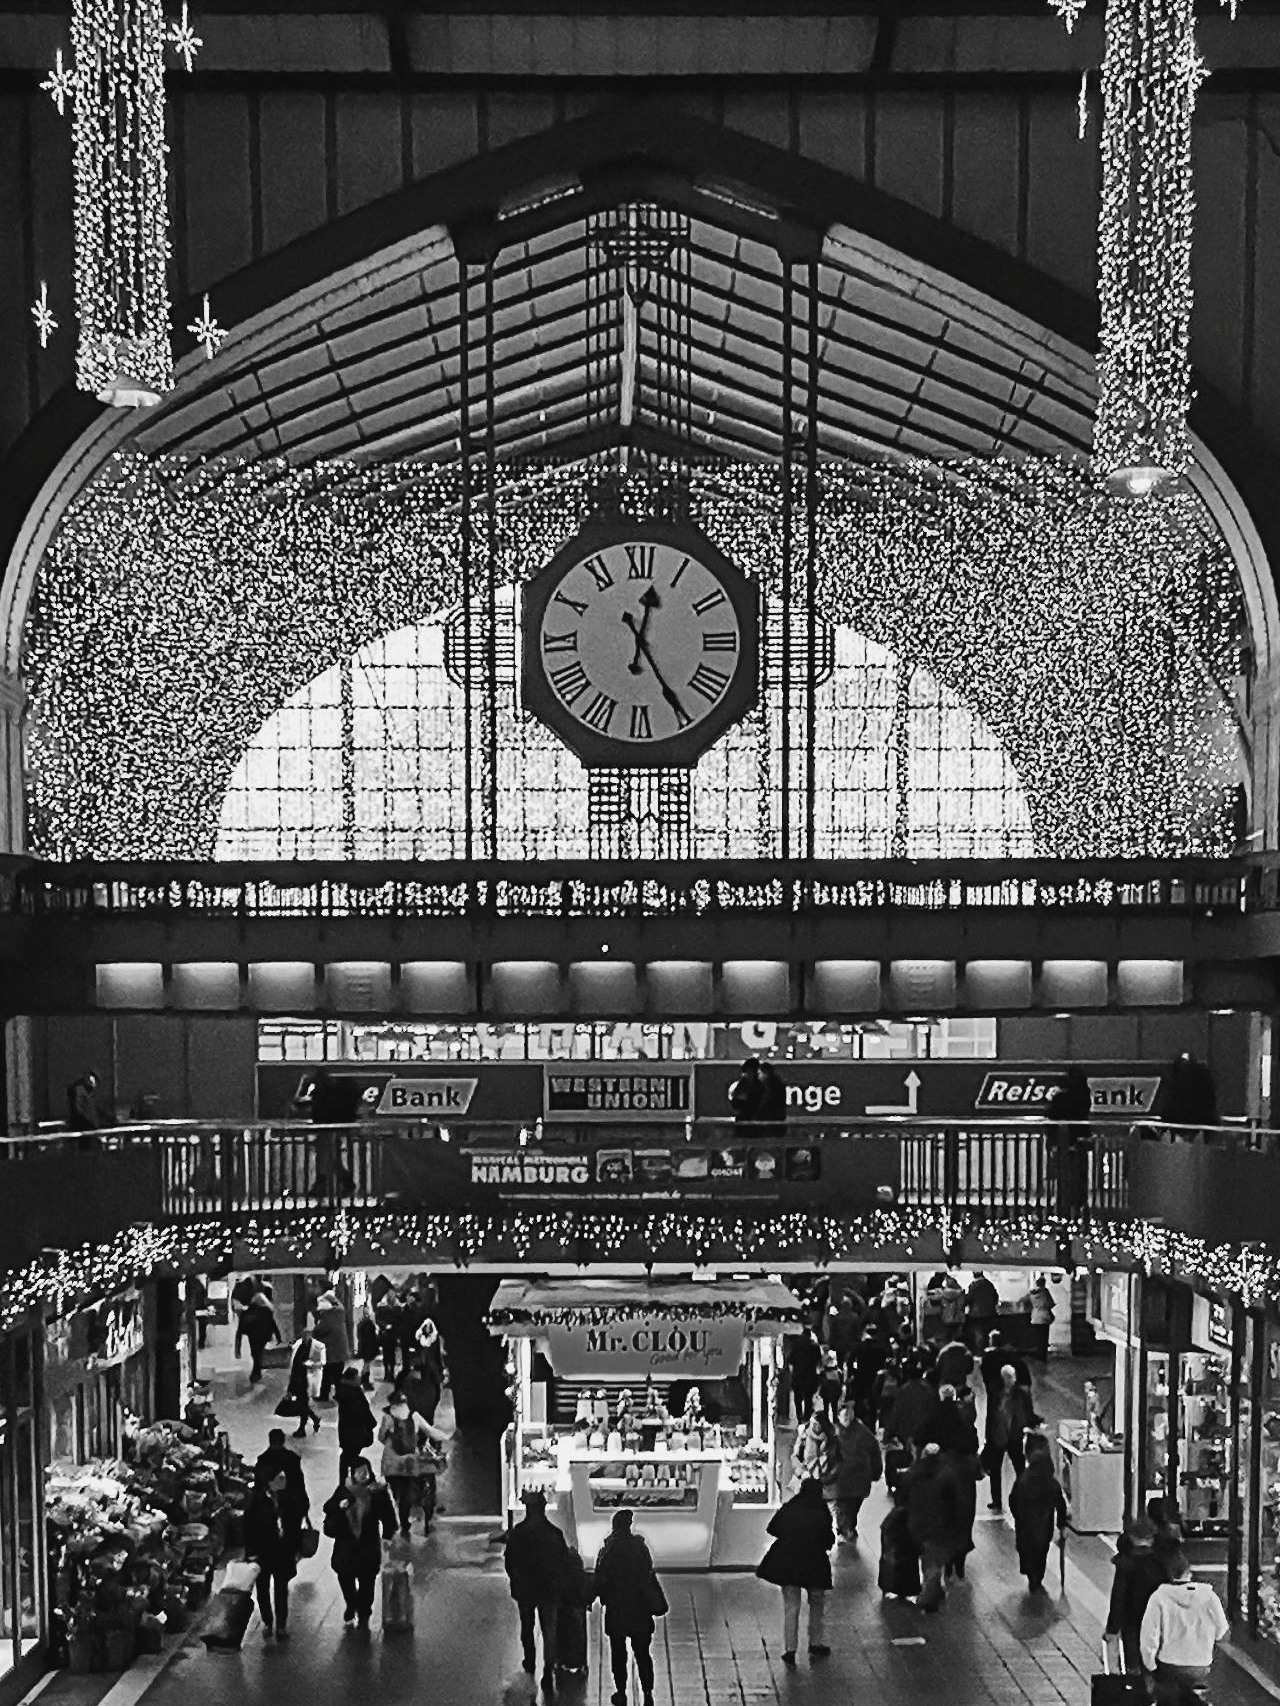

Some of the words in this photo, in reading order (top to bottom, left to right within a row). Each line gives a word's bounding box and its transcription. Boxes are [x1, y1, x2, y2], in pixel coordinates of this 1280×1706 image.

[551, 1077, 666, 1093] WESTERN
[391, 1086, 461, 1108] Bank
[586, 1092, 666, 1109] UNION
[1093, 1084, 1144, 1107] ank
[471, 1165, 590, 1184] HAMBURG
[586, 1329, 628, 1352] Mr.
[632, 1329, 711, 1353] CLOU
